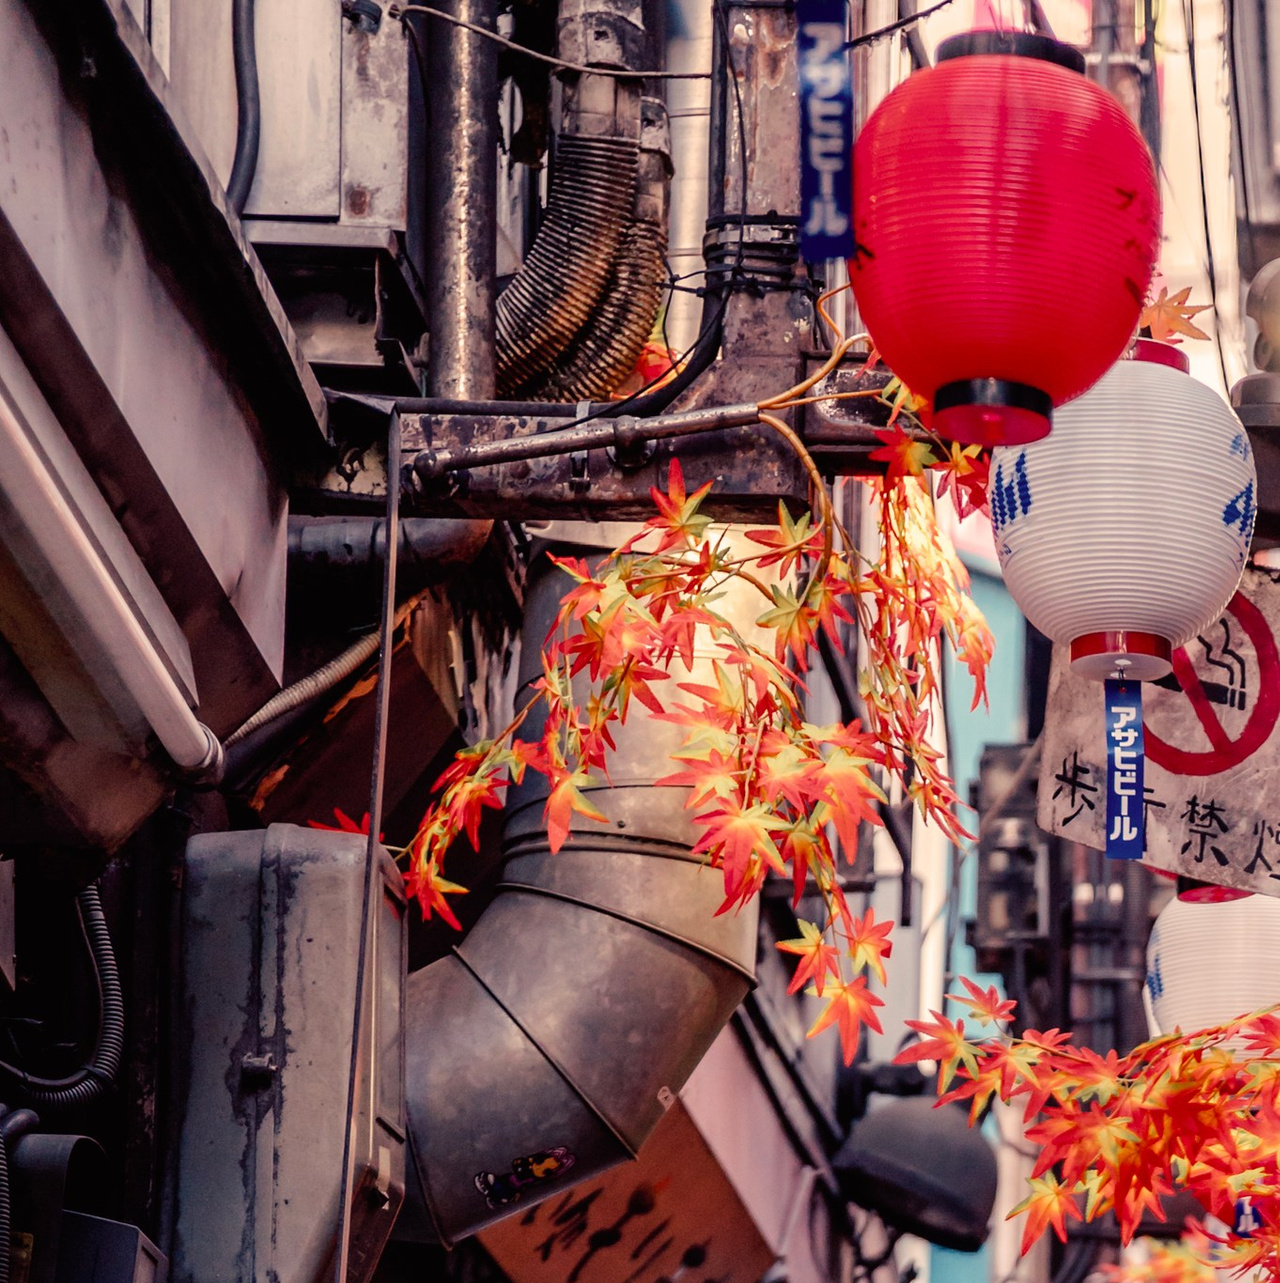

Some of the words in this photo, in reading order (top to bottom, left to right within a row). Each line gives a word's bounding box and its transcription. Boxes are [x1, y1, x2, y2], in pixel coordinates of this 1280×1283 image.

[1110, 706, 1138, 841] アサヒビール
